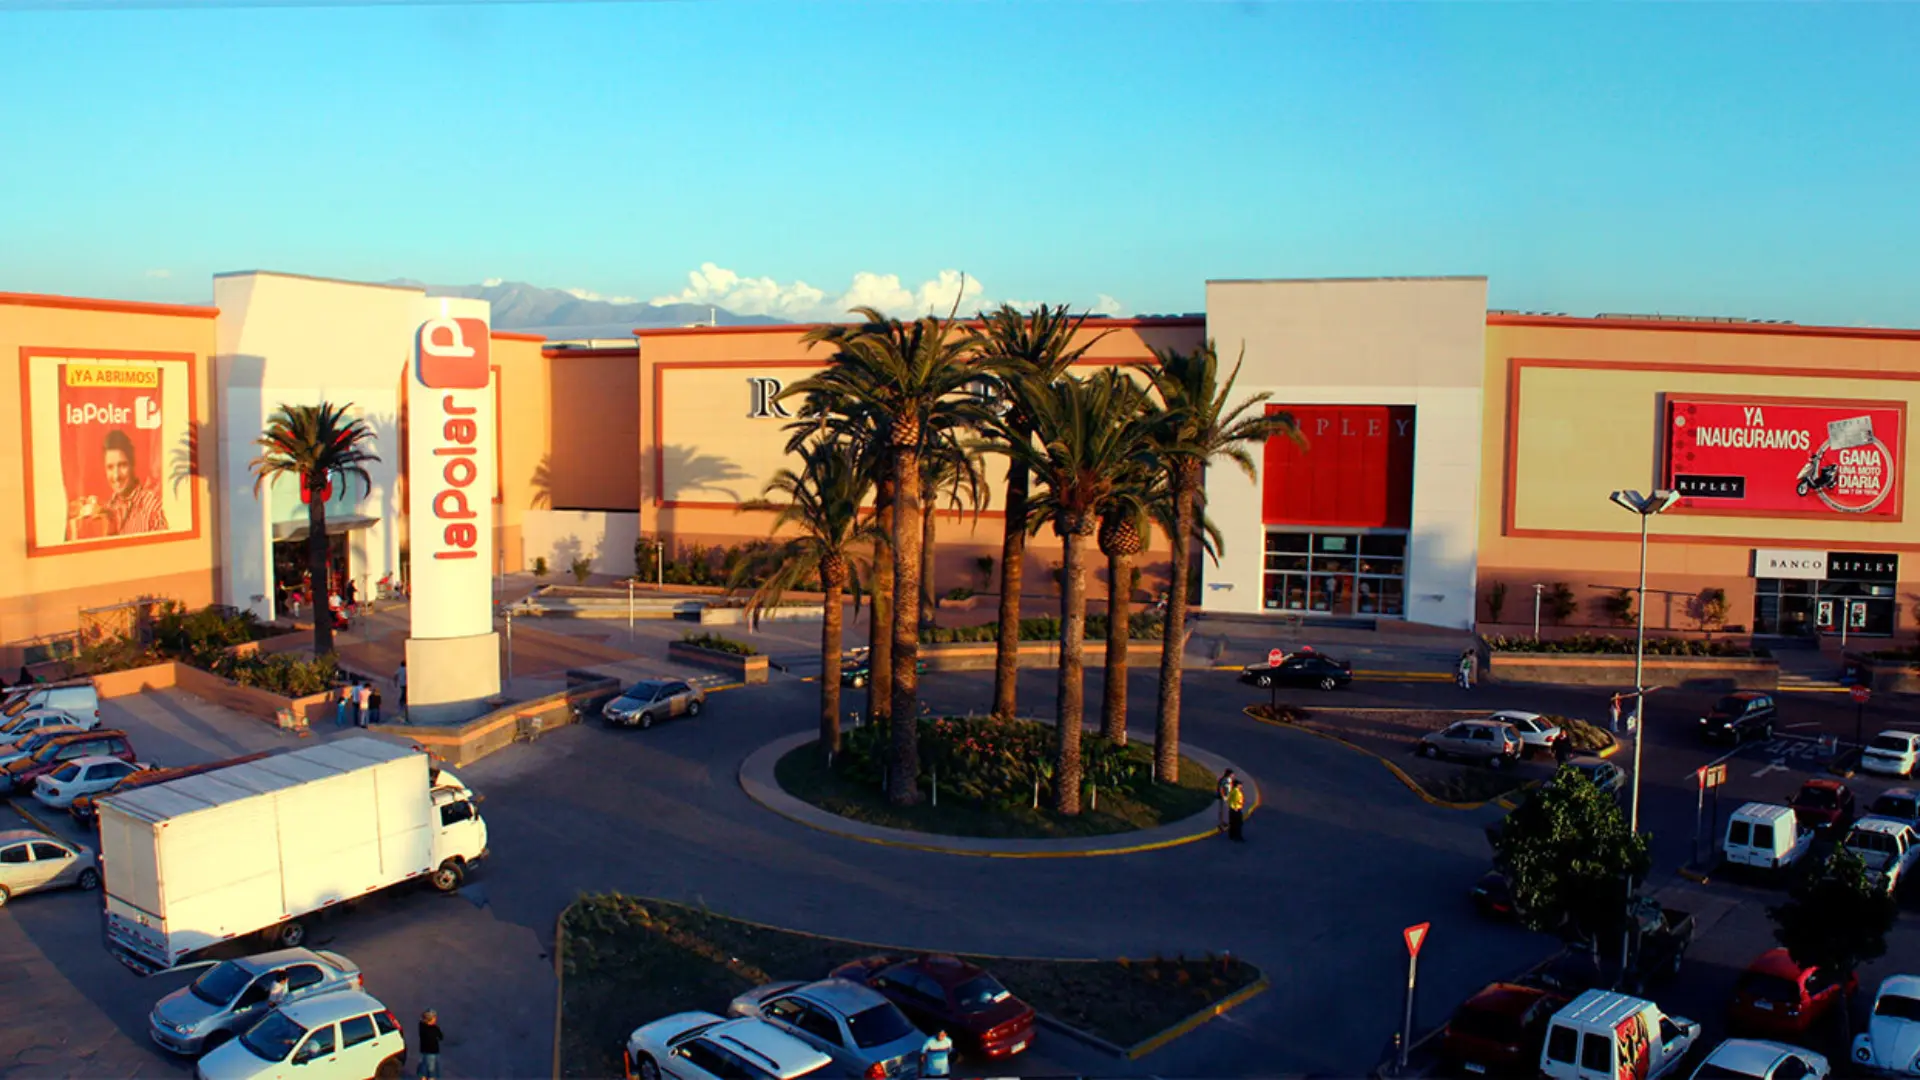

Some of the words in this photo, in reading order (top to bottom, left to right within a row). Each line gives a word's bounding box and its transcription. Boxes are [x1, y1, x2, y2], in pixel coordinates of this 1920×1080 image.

[96, 370, 156, 384] ABRIMOS!
[66, 402, 131, 424] laPolar
[1743, 406, 1765, 427] YA
[1266, 417, 1411, 437] IPLEY
[1695, 425, 1811, 451] INAUGURAMOS
[1839, 449, 1881, 466] GANA
[434, 394, 478, 560] laPolar
[1838, 474, 1881, 490] DIARIA
[1680, 481, 1739, 492] RIPLEY
[1769, 559, 1822, 570] BANCO
[1832, 560, 1894, 573] RIPLEY
